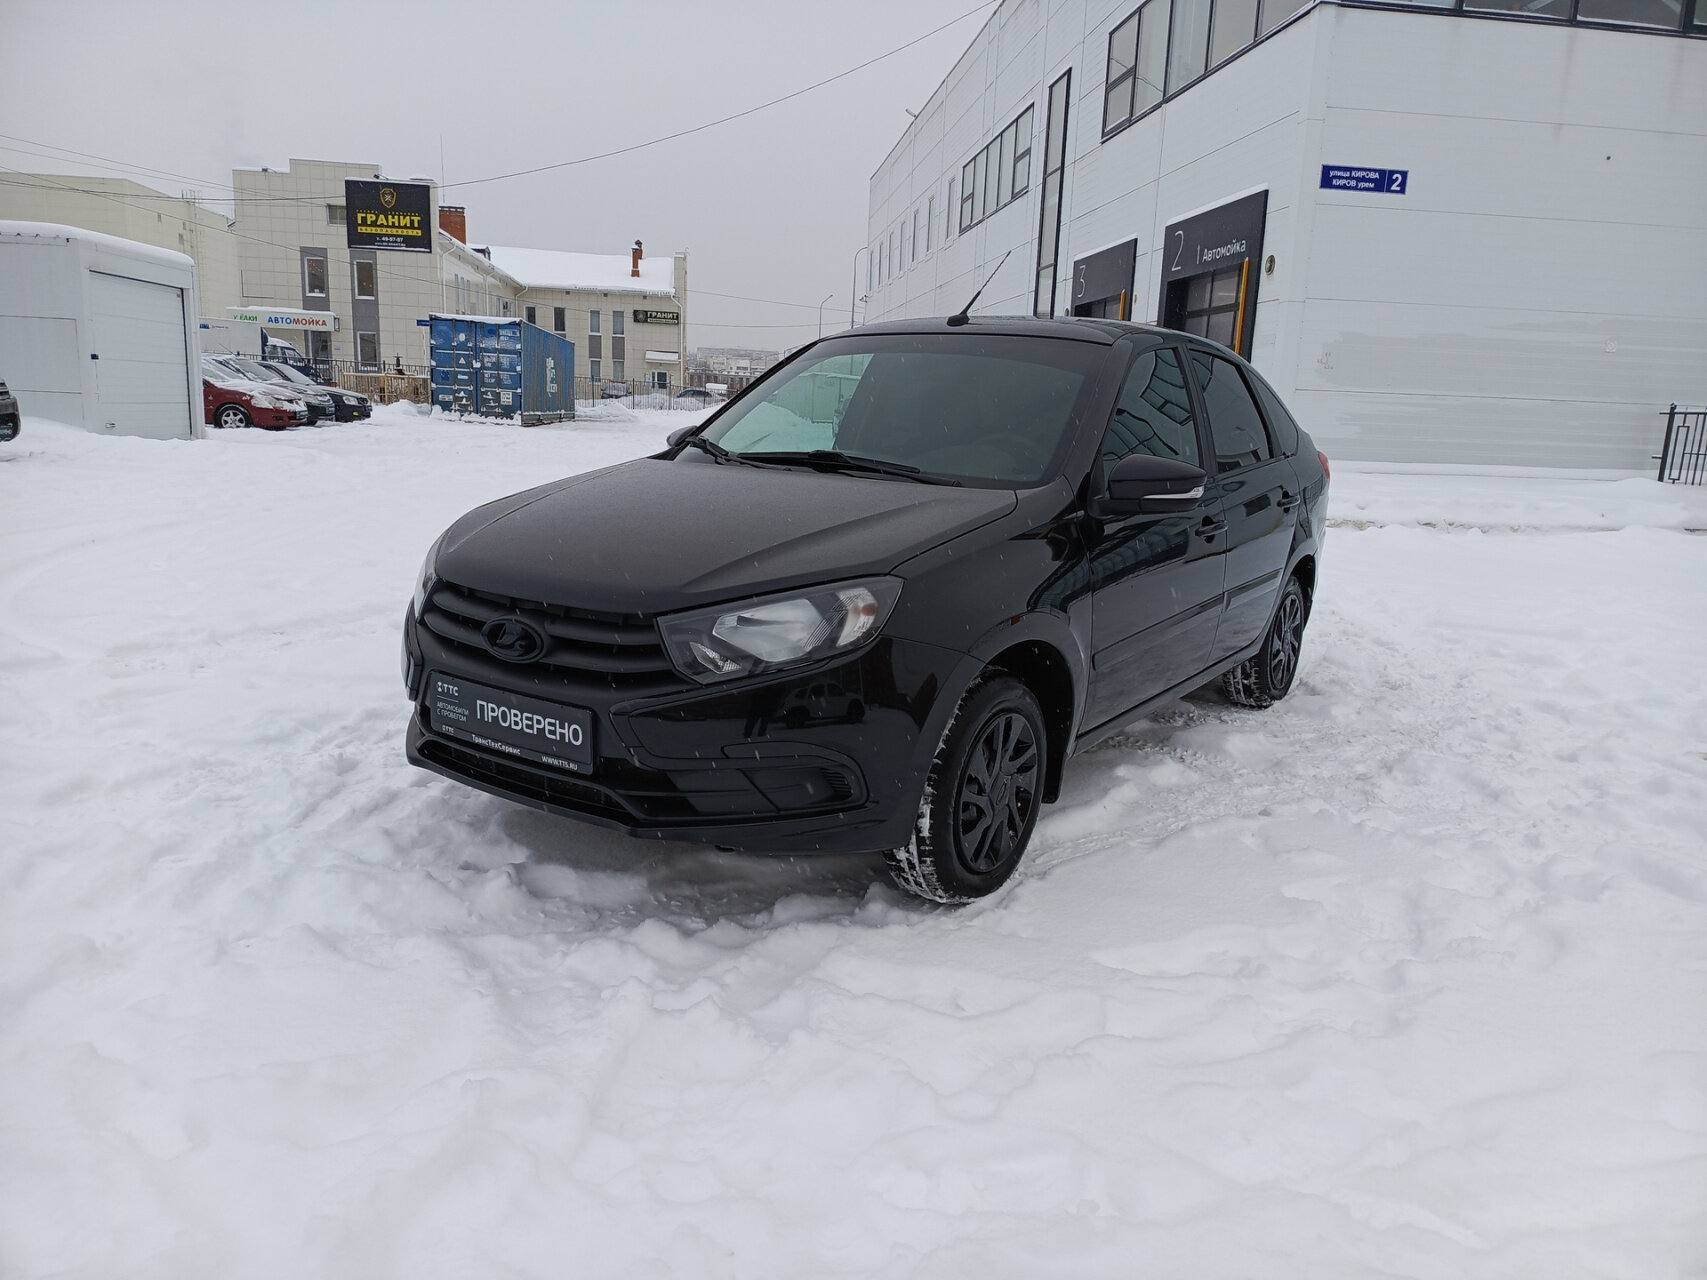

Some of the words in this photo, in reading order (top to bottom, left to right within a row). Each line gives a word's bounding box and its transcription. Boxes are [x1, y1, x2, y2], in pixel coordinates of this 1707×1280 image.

[1351, 170, 1379, 179] КИРОВА
[1390, 173, 1402, 191] 2
[1332, 179, 1356, 187] КИРОВ
[1357, 181, 1375, 189] урем
[356, 212, 421, 228] ГРАНИТ
[1171, 229, 1185, 272] 2
[1202, 238, 1247, 263] Автомойка
[1077, 264, 1086, 298] 3
[267, 316, 328, 327] АВТОМОЙКА
[647, 311, 678, 319] ГРАНИТ
[443, 683, 459, 697] ТТС
[436, 701, 470, 716] АВТОМОБИЛИ
[441, 709, 467, 722] ПРОБЕГОМ
[476, 700, 583, 746] ПРОВЕРЕНО
[471, 734, 521, 755] ТрансТехСервис
